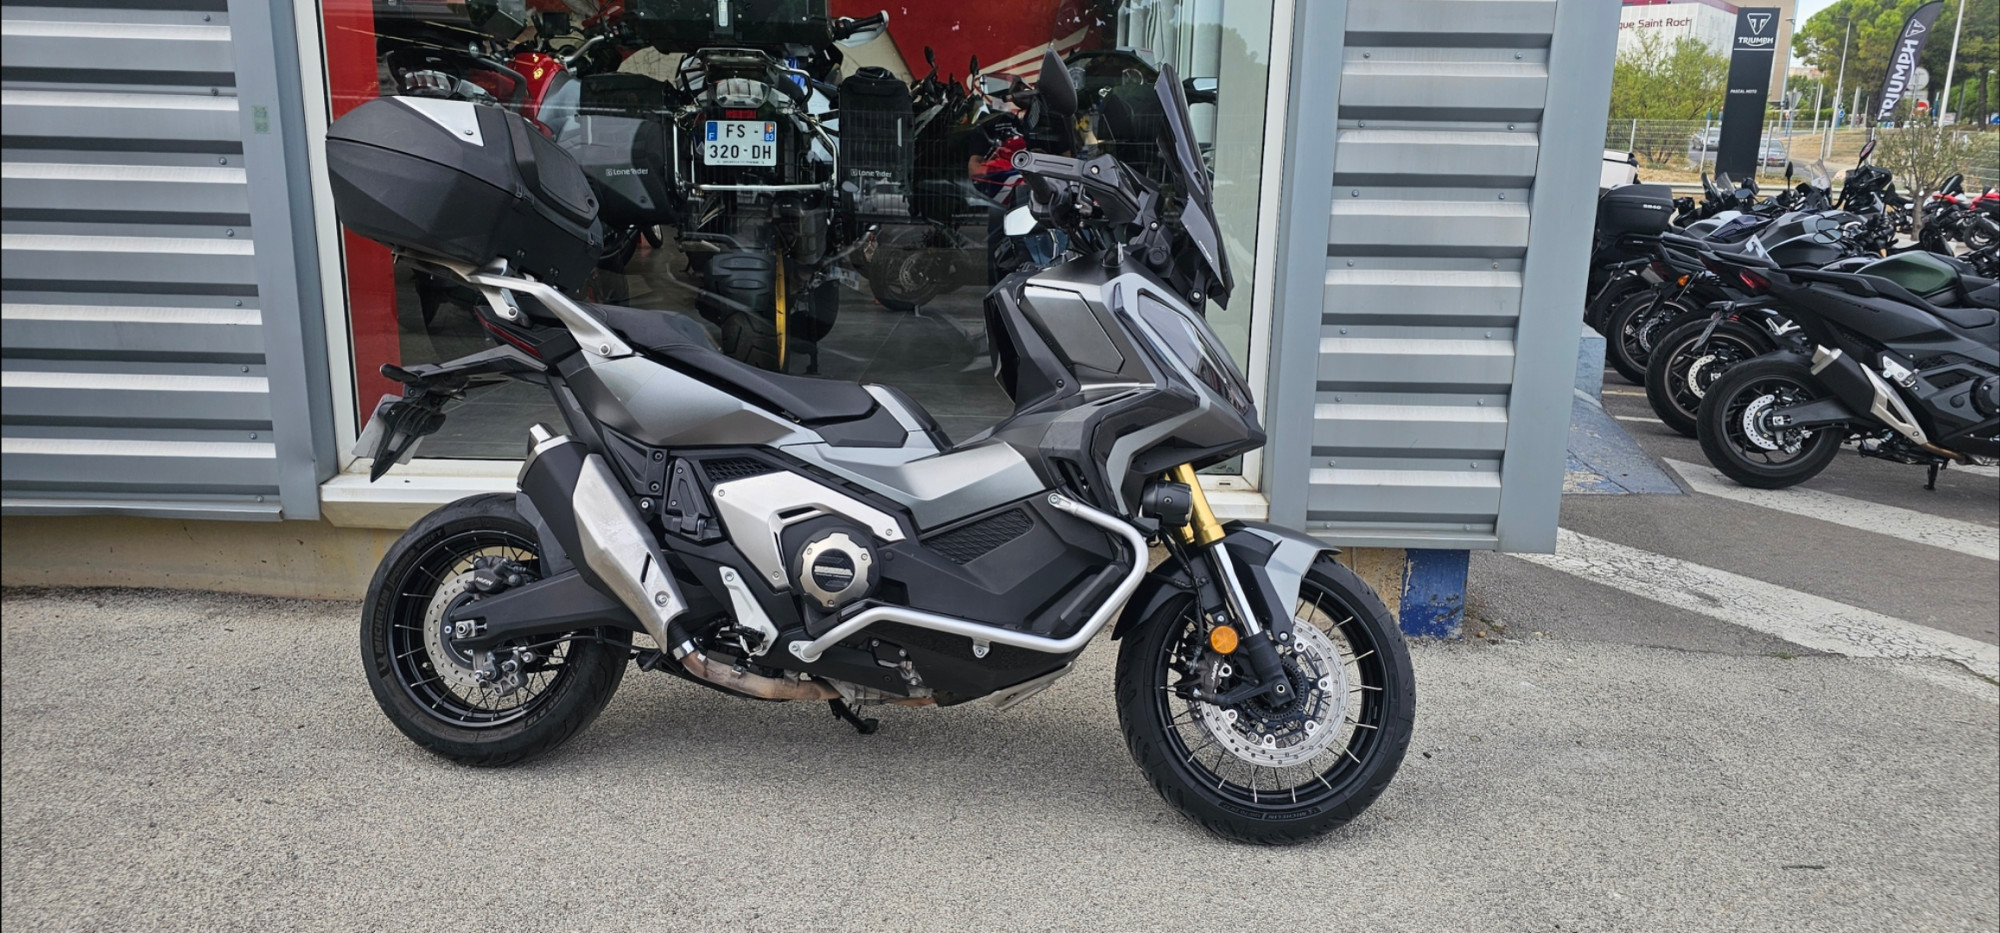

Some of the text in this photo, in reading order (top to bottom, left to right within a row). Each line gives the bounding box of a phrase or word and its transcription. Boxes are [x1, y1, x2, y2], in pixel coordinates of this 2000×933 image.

[1638, 19, 1663, 28] Saint
[1666, 17, 1692, 27] Roch
[1738, 37, 1774, 46] TRIUMPH
[1877, 39, 1919, 120] TRIUMPH
[708, 132, 715, 140] F
[726, 124, 746, 138] FS
[765, 133, 774, 141] 83
[613, 168, 630, 176] Lone
[374, 589, 390, 657] MICHELIN
